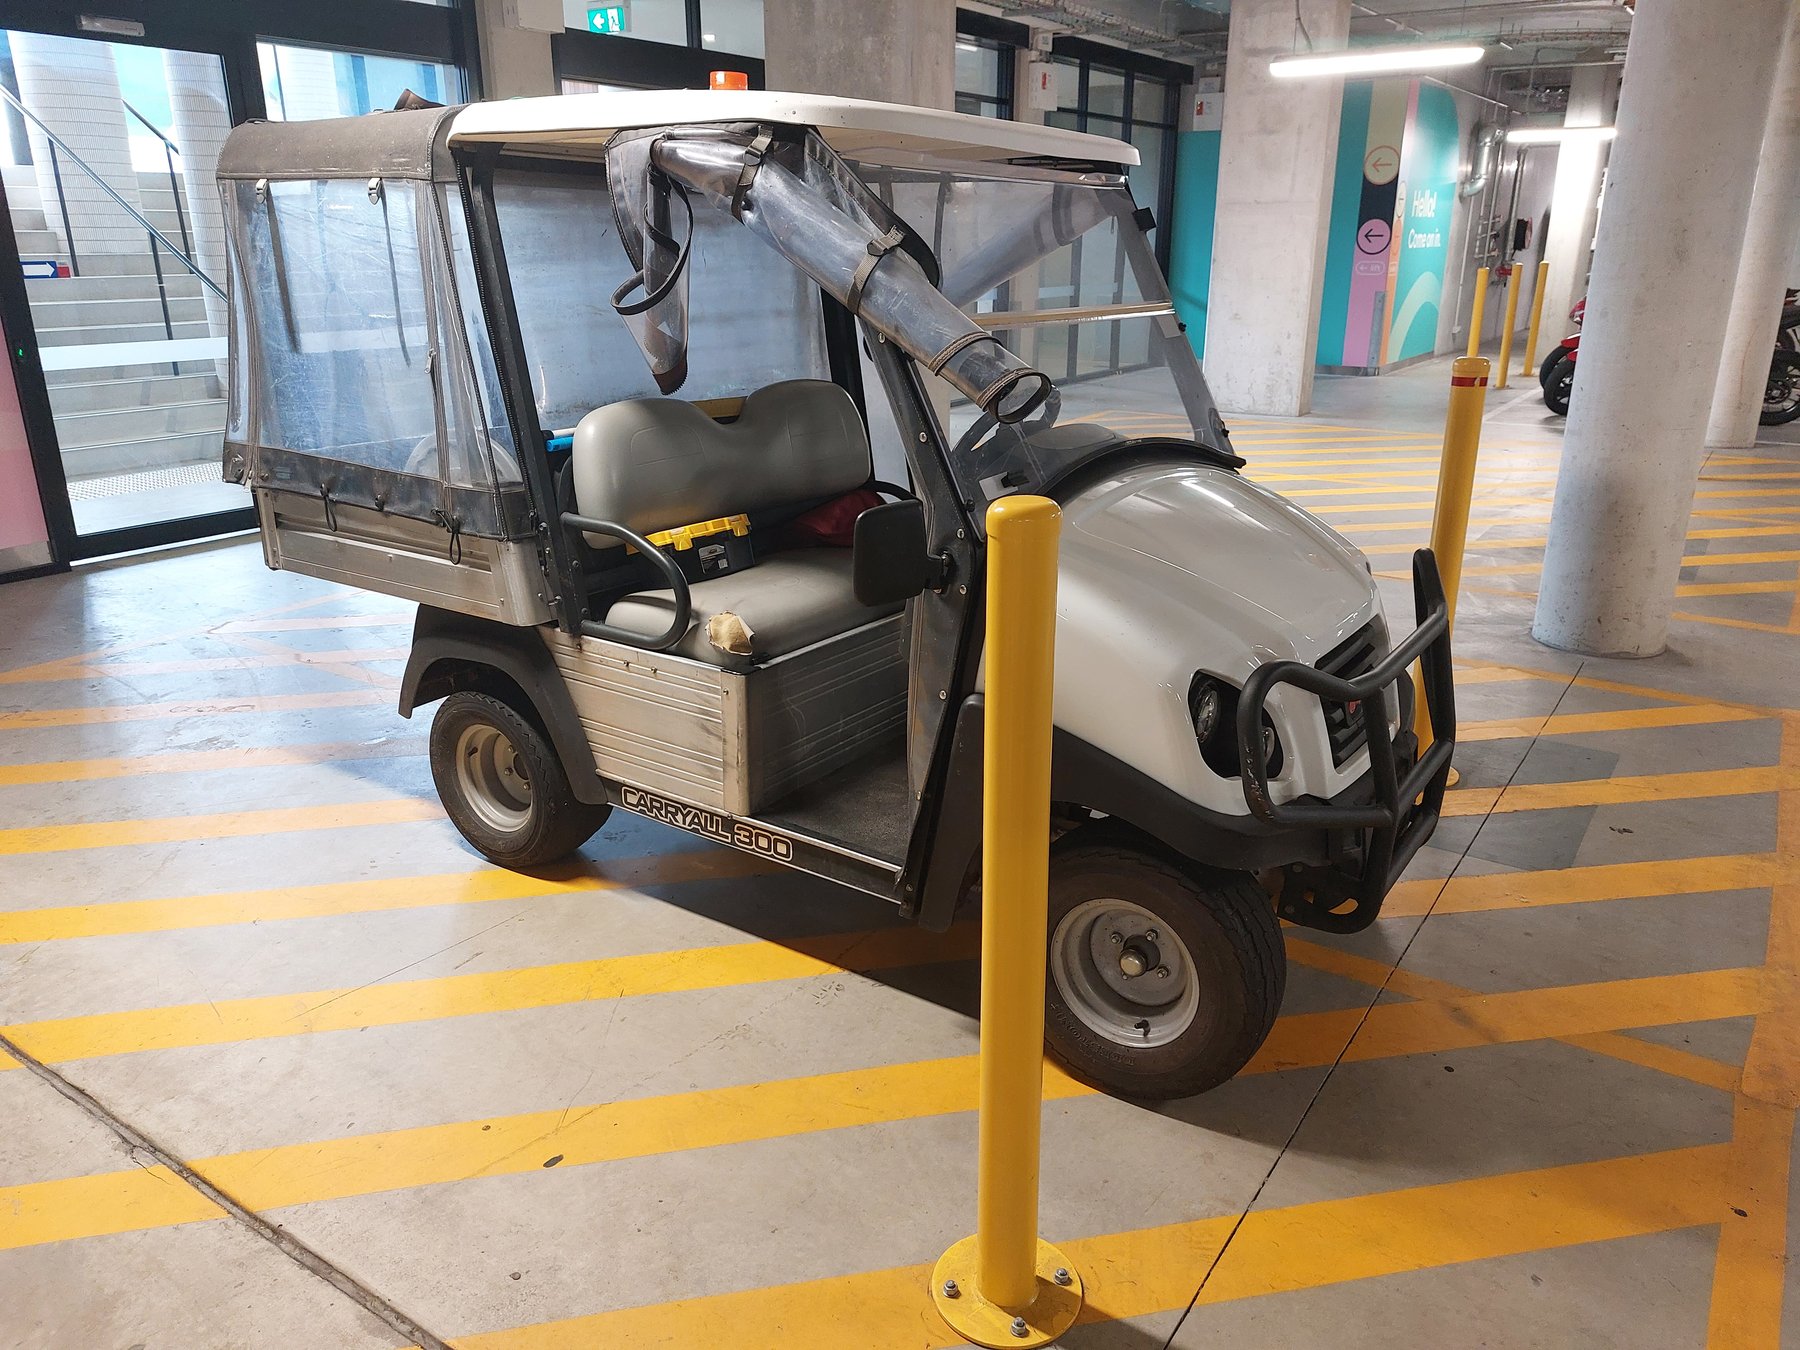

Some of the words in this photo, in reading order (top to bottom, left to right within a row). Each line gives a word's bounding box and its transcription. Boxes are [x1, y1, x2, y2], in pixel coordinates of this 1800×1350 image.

[1411, 189, 1437, 217] Hello!
[1408, 228, 1426, 248] Come
[621, 786, 732, 843] CARRYALL
[734, 823, 793, 862] 300
